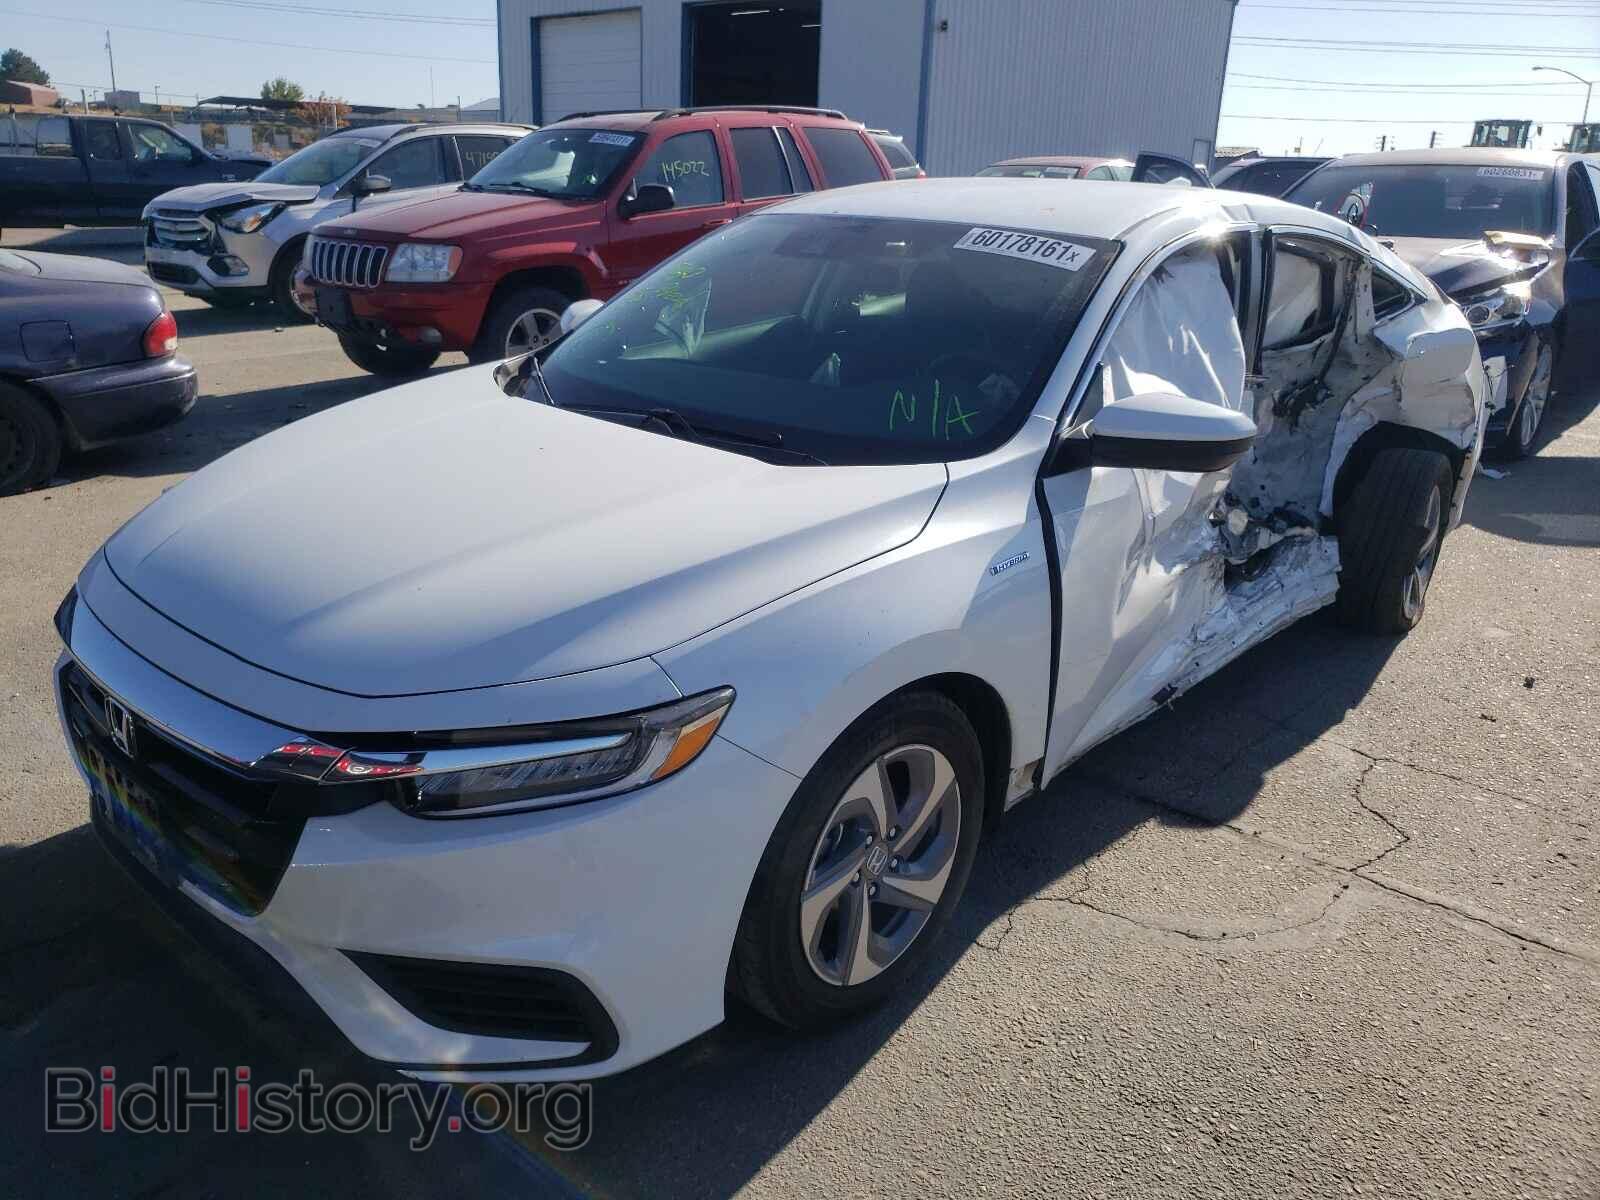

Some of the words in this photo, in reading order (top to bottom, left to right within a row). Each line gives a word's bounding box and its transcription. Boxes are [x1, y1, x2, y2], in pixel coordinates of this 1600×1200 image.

[662, 160, 710, 182] 145022
[889, 379, 981, 440] N/A
[996, 552, 1029, 573] HYBRID
